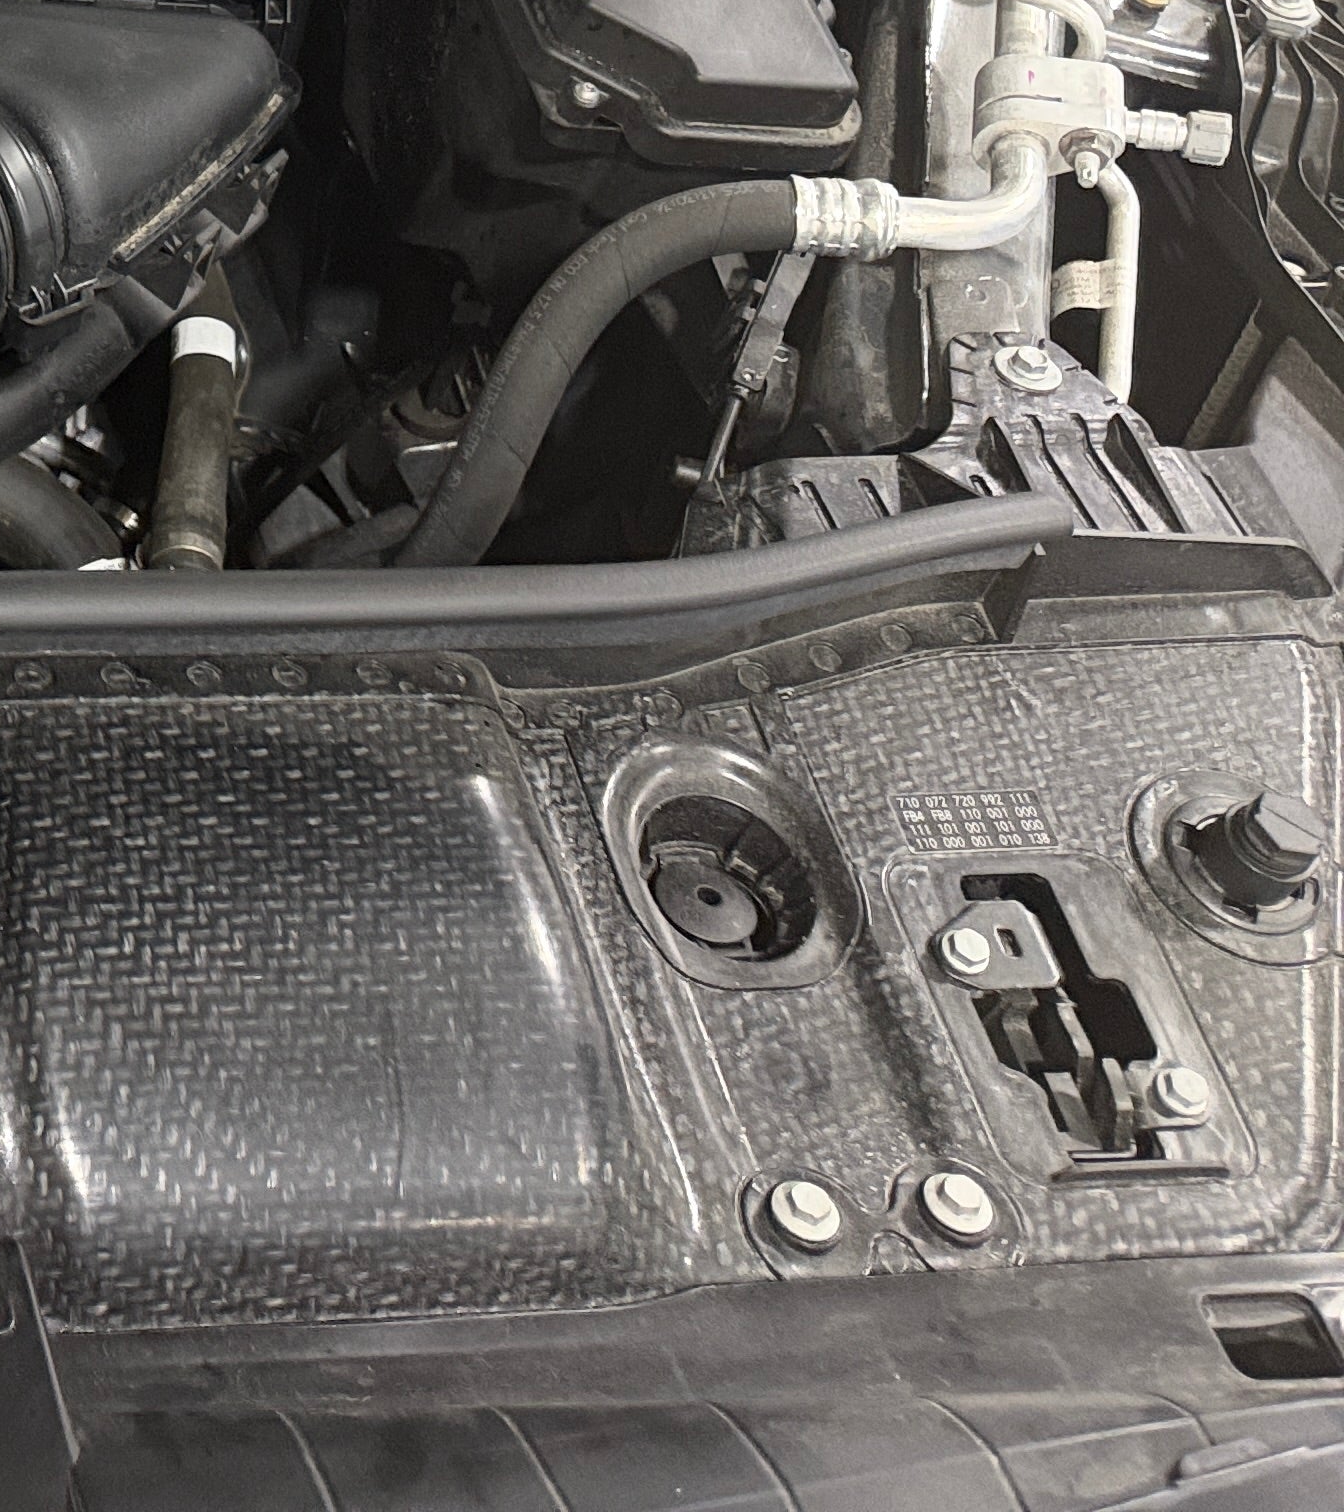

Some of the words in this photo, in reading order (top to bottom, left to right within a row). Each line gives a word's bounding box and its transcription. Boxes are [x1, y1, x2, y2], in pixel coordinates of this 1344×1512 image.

[896, 797, 919, 808] 710
[925, 797, 948, 808] 072
[952, 795, 975, 806] 720
[980, 794, 1004, 805] 992
[1009, 793, 1030, 804] 111
[960, 809, 981, 819] 110
[986, 808, 1008, 818] 001
[1015, 806, 1037, 817] 000
[910, 824, 931, 835] 111
[938, 823, 959, 834] 101
[965, 822, 987, 833] 001
[993, 821, 1015, 832] 101
[1021, 820, 1044, 831] 000
[916, 838, 937, 849] 110
[943, 837, 965, 848] 000
[971, 836, 993, 847] 001
[999, 835, 1022, 845] 010
